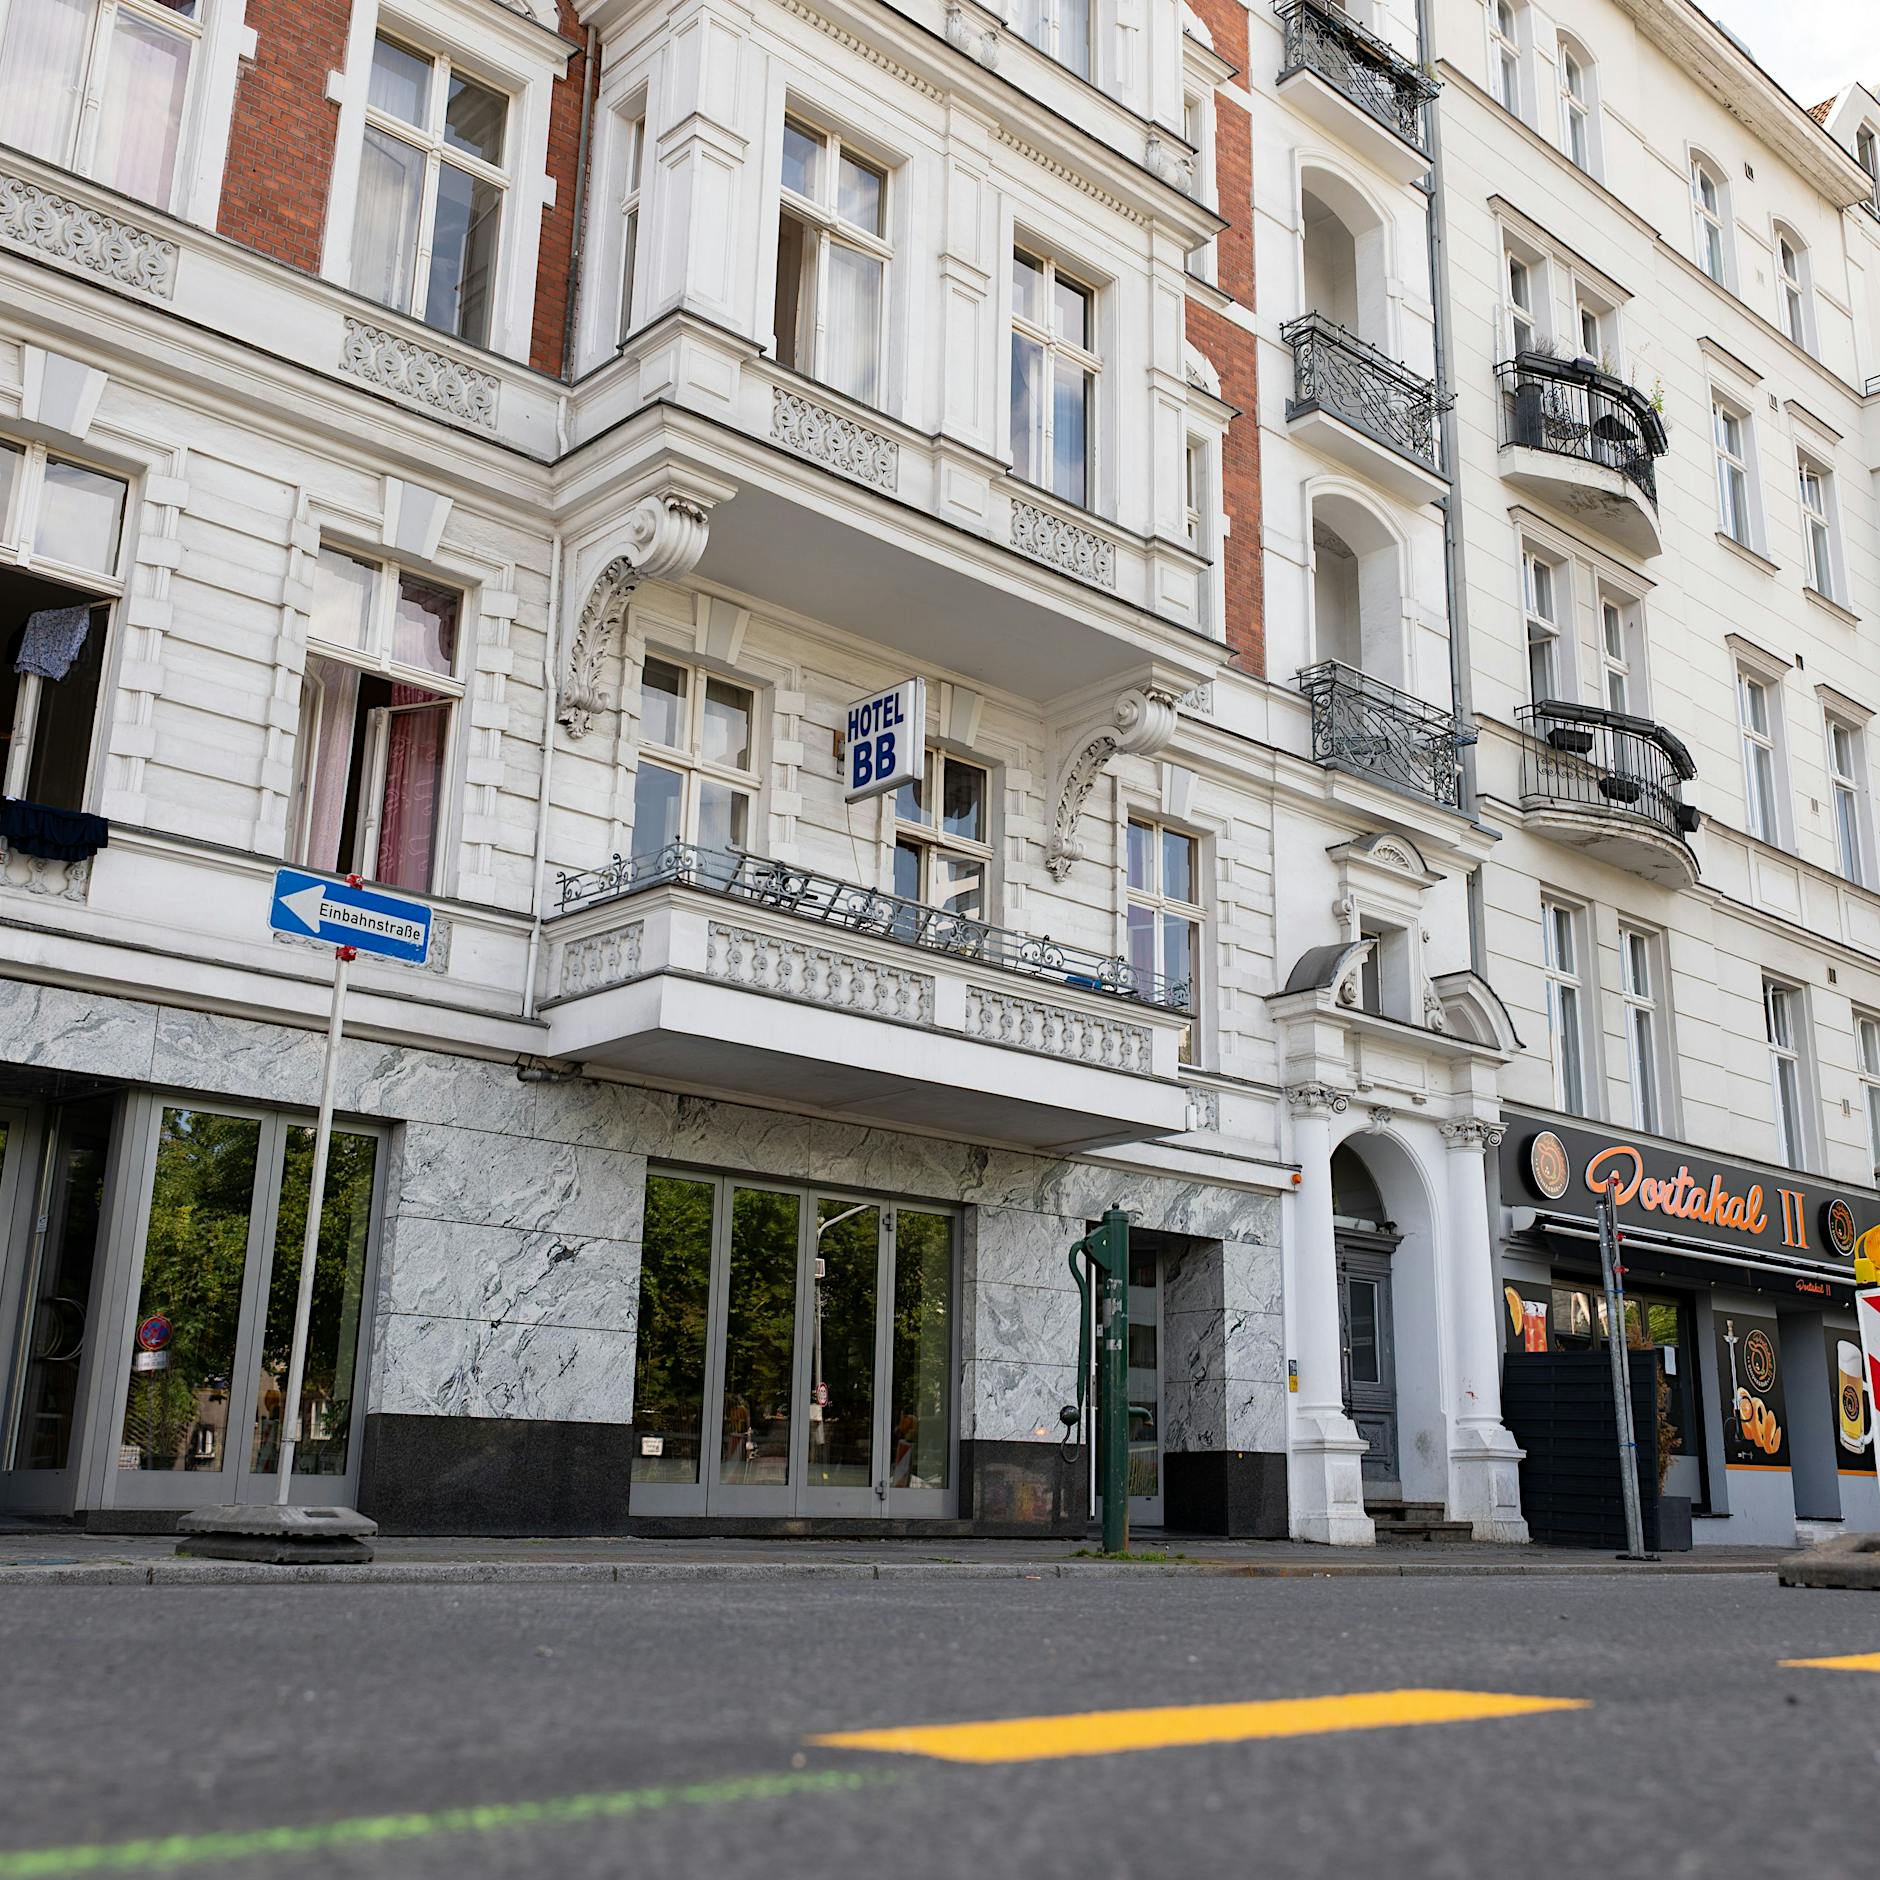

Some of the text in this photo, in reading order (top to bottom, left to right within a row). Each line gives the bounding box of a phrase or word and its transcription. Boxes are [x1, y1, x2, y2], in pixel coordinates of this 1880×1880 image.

[848, 693, 904, 743] HOTEL
[853, 732, 896, 789] BB
[320, 903, 421, 940] Einbahnstraße
[1585, 1145, 1768, 1235] Portakal
[1777, 1188, 1810, 1249] II
